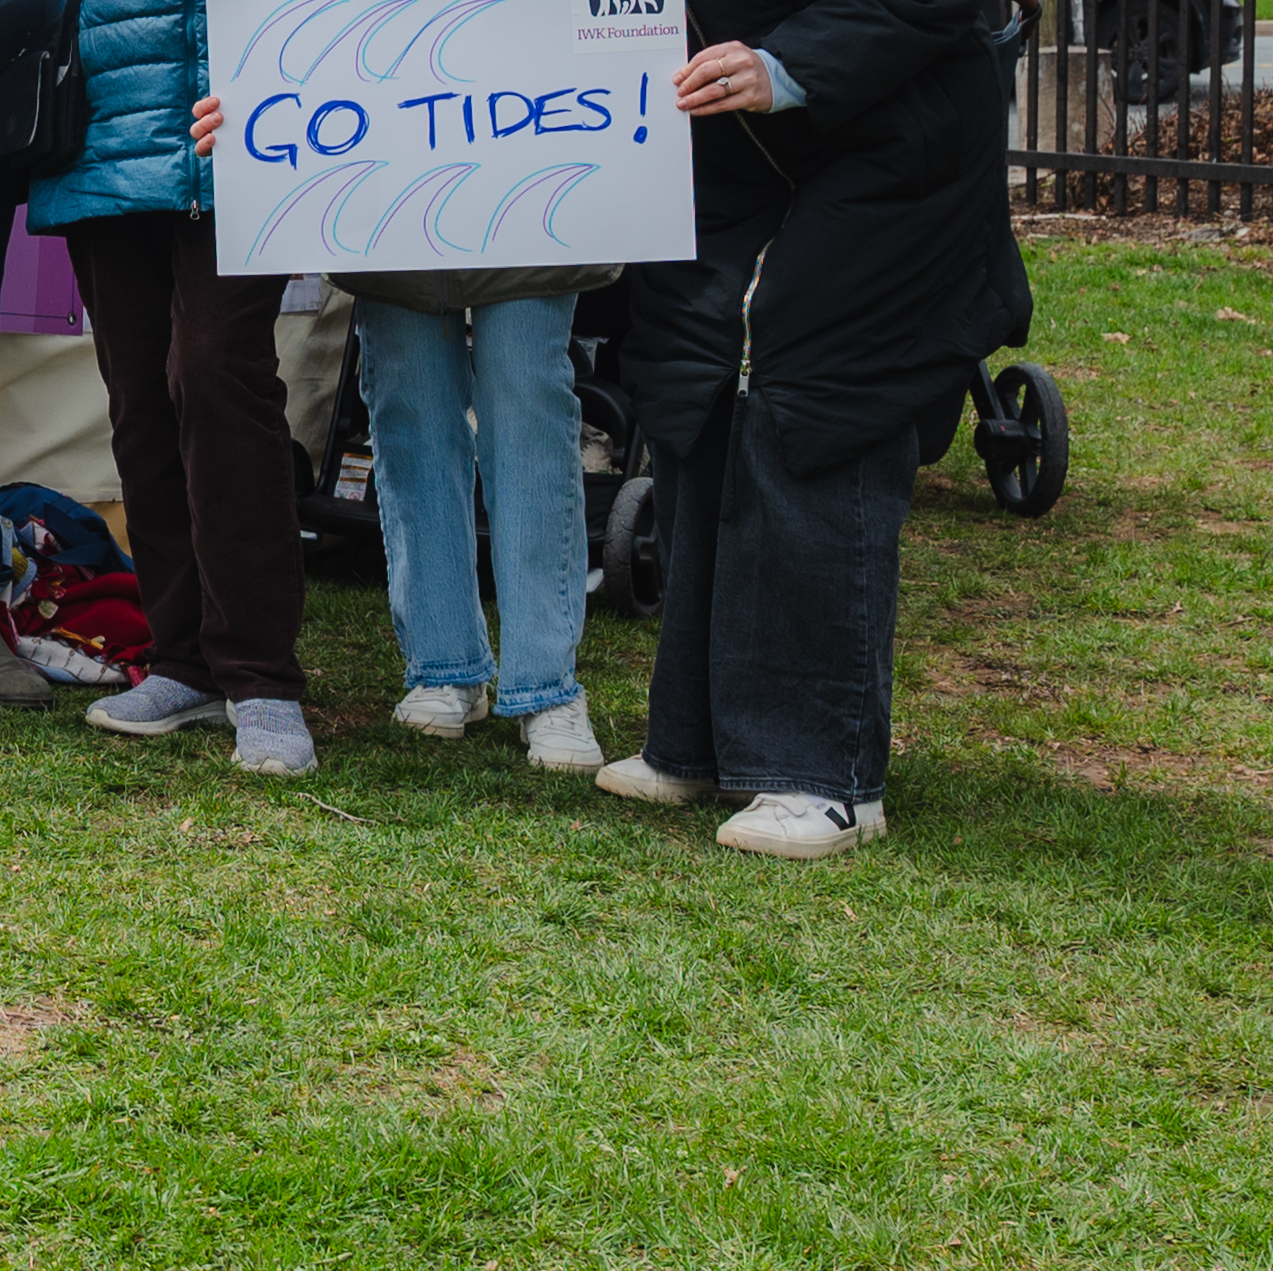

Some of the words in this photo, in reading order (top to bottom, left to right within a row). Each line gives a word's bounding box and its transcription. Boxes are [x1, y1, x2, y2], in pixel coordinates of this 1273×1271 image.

[577, 28, 606, 41] IWK
[607, 23, 680, 39] Foundation
[244, 92, 370, 170] GO
